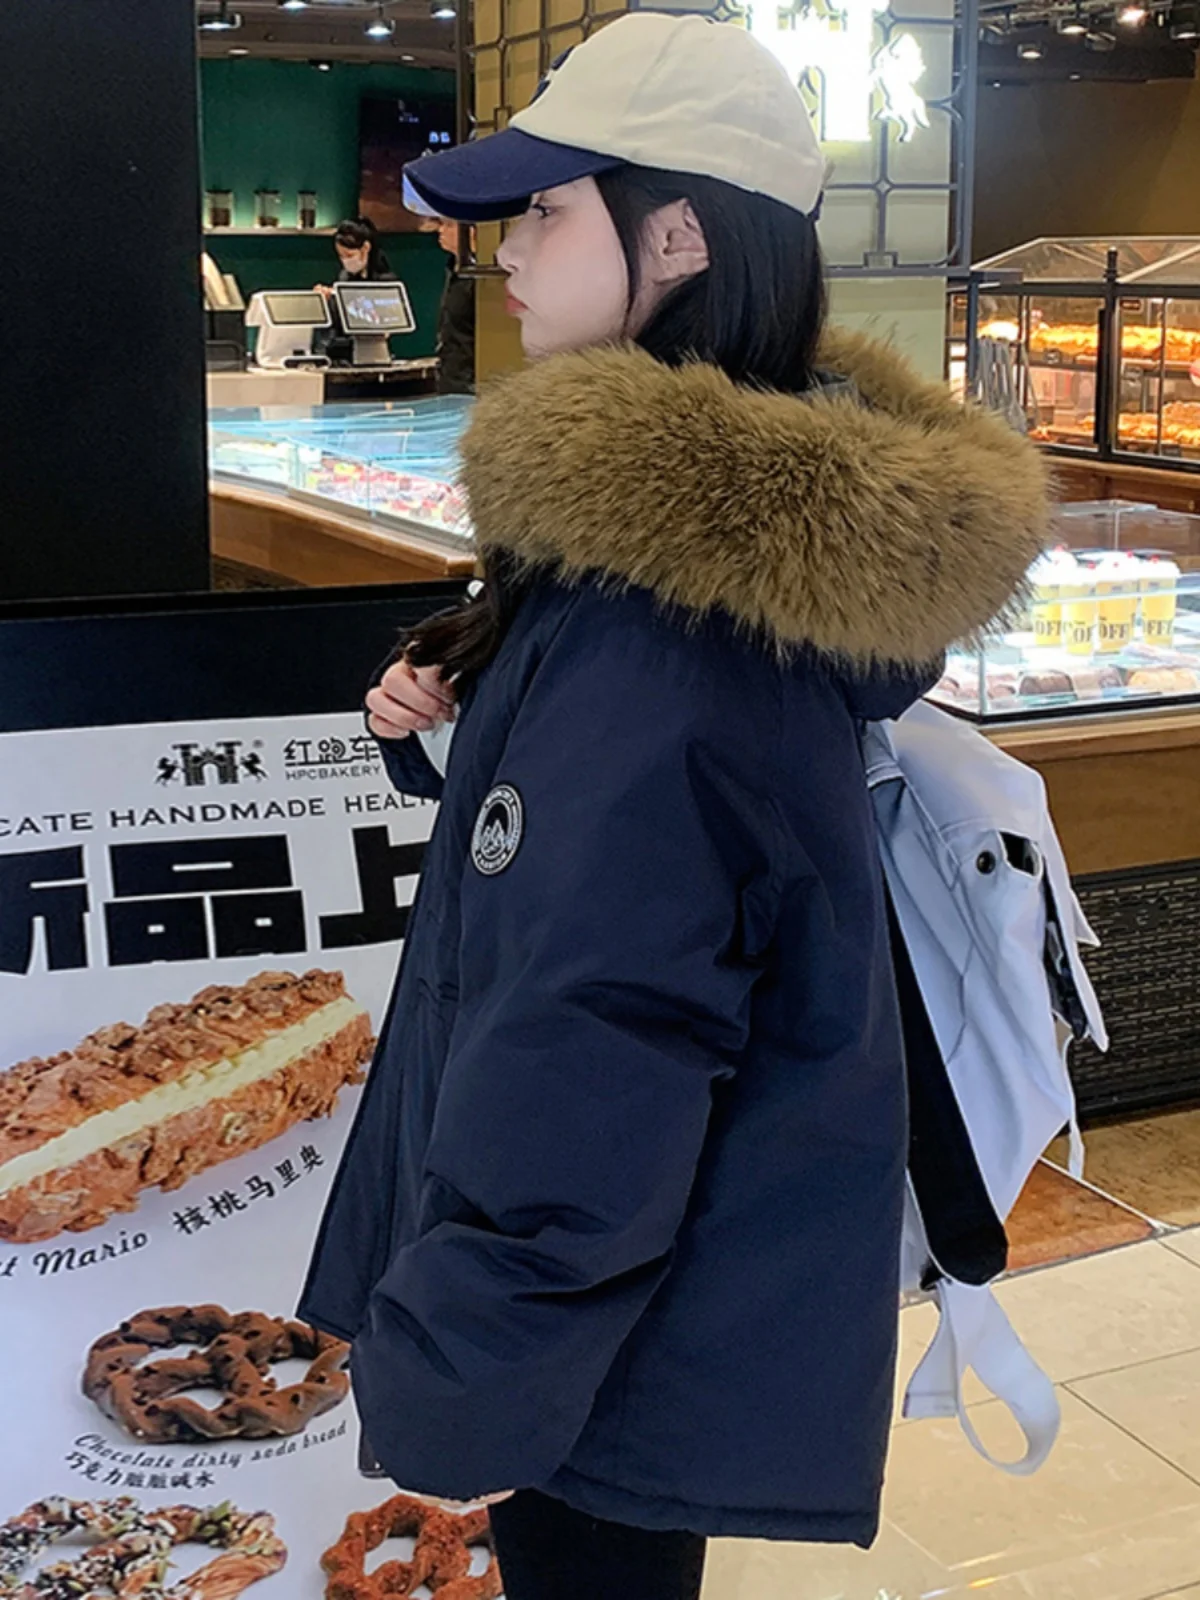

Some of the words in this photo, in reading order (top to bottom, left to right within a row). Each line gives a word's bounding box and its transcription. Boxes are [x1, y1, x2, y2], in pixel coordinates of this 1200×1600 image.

[285, 765, 380, 781] HPCBAKERY
[110, 797, 326, 829] HANDMADE
[172, 1144, 325, 1235] 核桃马里奥
[32, 1229, 148, 1275] Mario
[181, 1451, 242, 1469] dirty
[250, 1440, 297, 1462] soda
[302, 1419, 346, 1449] bread
